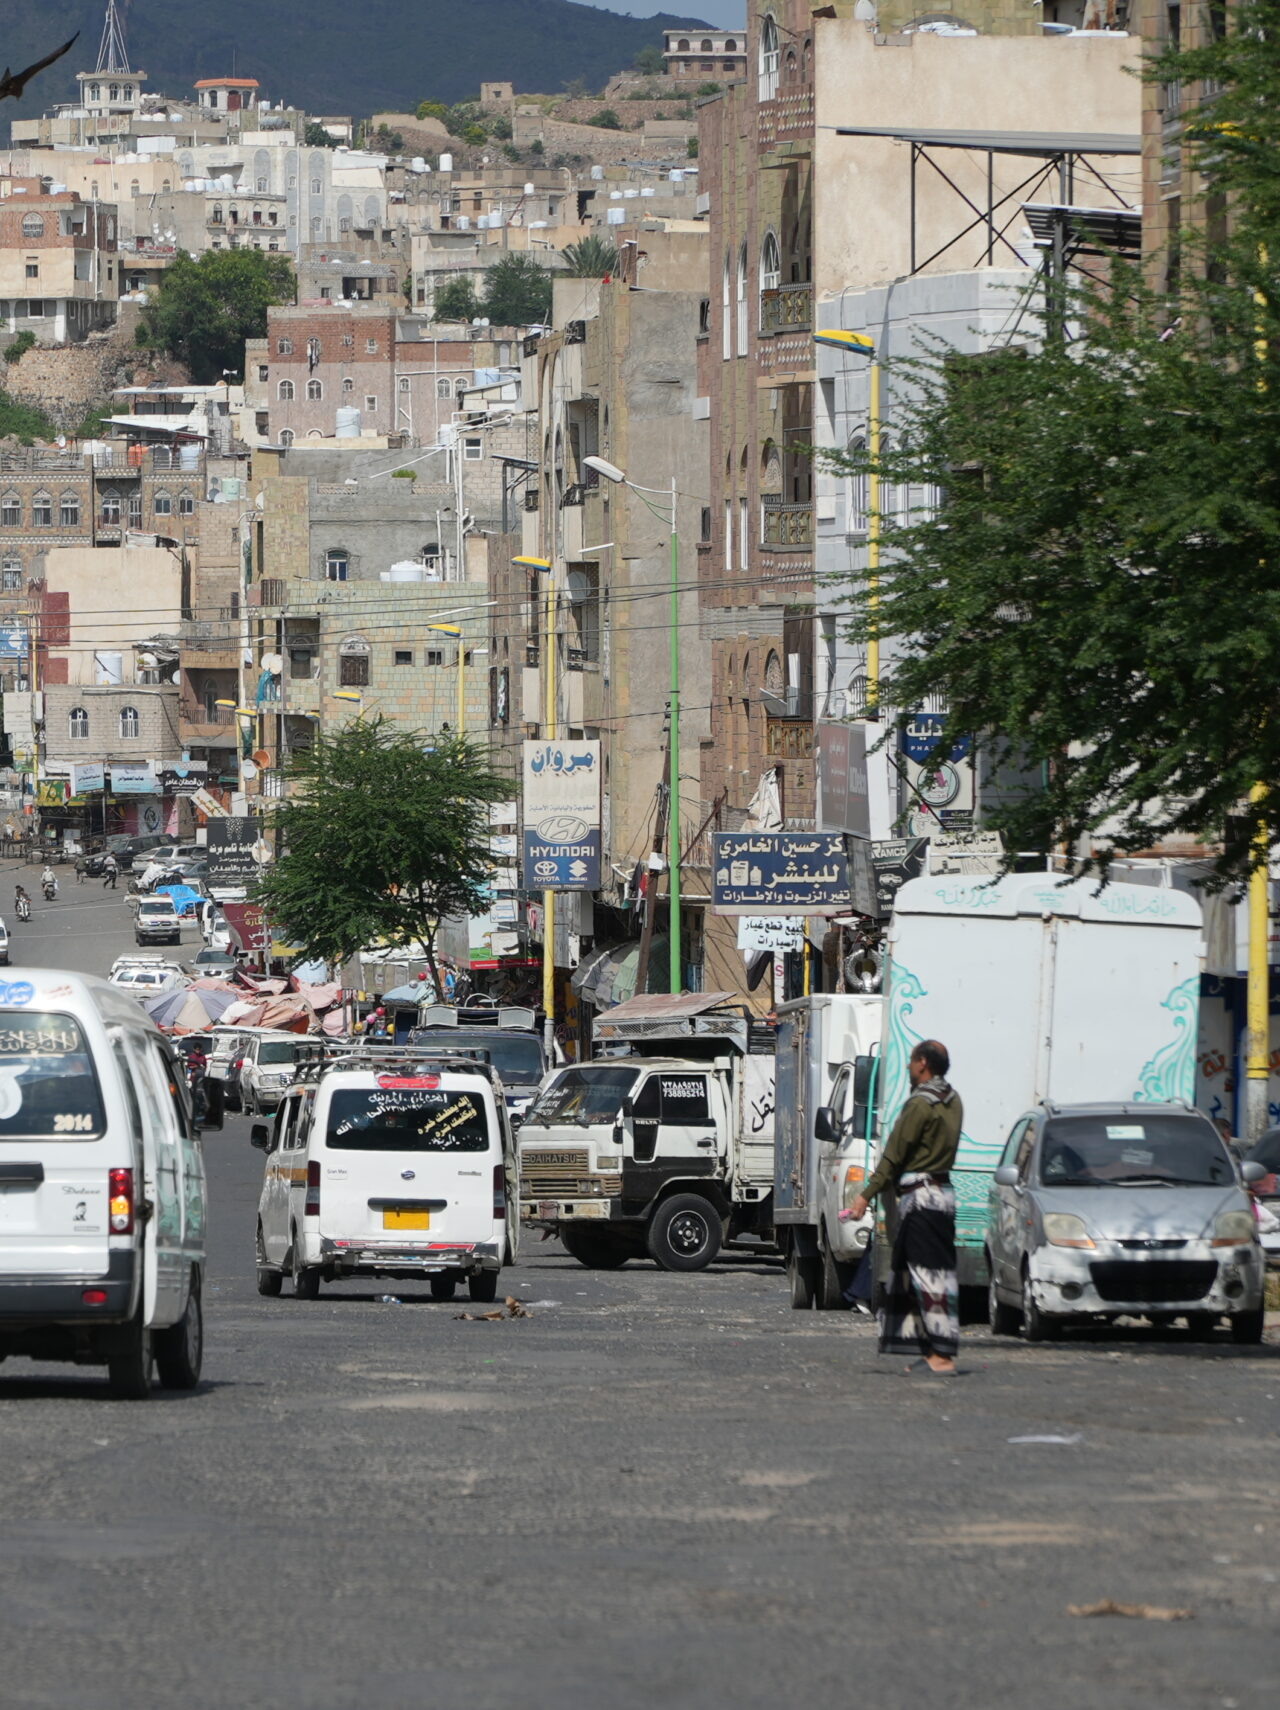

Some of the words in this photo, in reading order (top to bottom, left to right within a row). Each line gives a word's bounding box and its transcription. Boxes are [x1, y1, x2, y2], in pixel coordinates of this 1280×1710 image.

[531, 746, 594, 773] مروان
[530, 846, 595, 857] HYUNDAI
[719, 837, 778, 858] الخامري
[782, 838, 821, 857] حسين
[871, 843, 907, 858] RAMCO
[764, 861, 840, 889] للبنشر
[722, 890, 782, 903] والإطارات
[784, 890, 827, 903] الزيوت
[663, 1089, 705, 1098] 738895214
[54, 1114, 94, 1131] 2014
[528, 1153, 578, 1164] DAIHATSU
